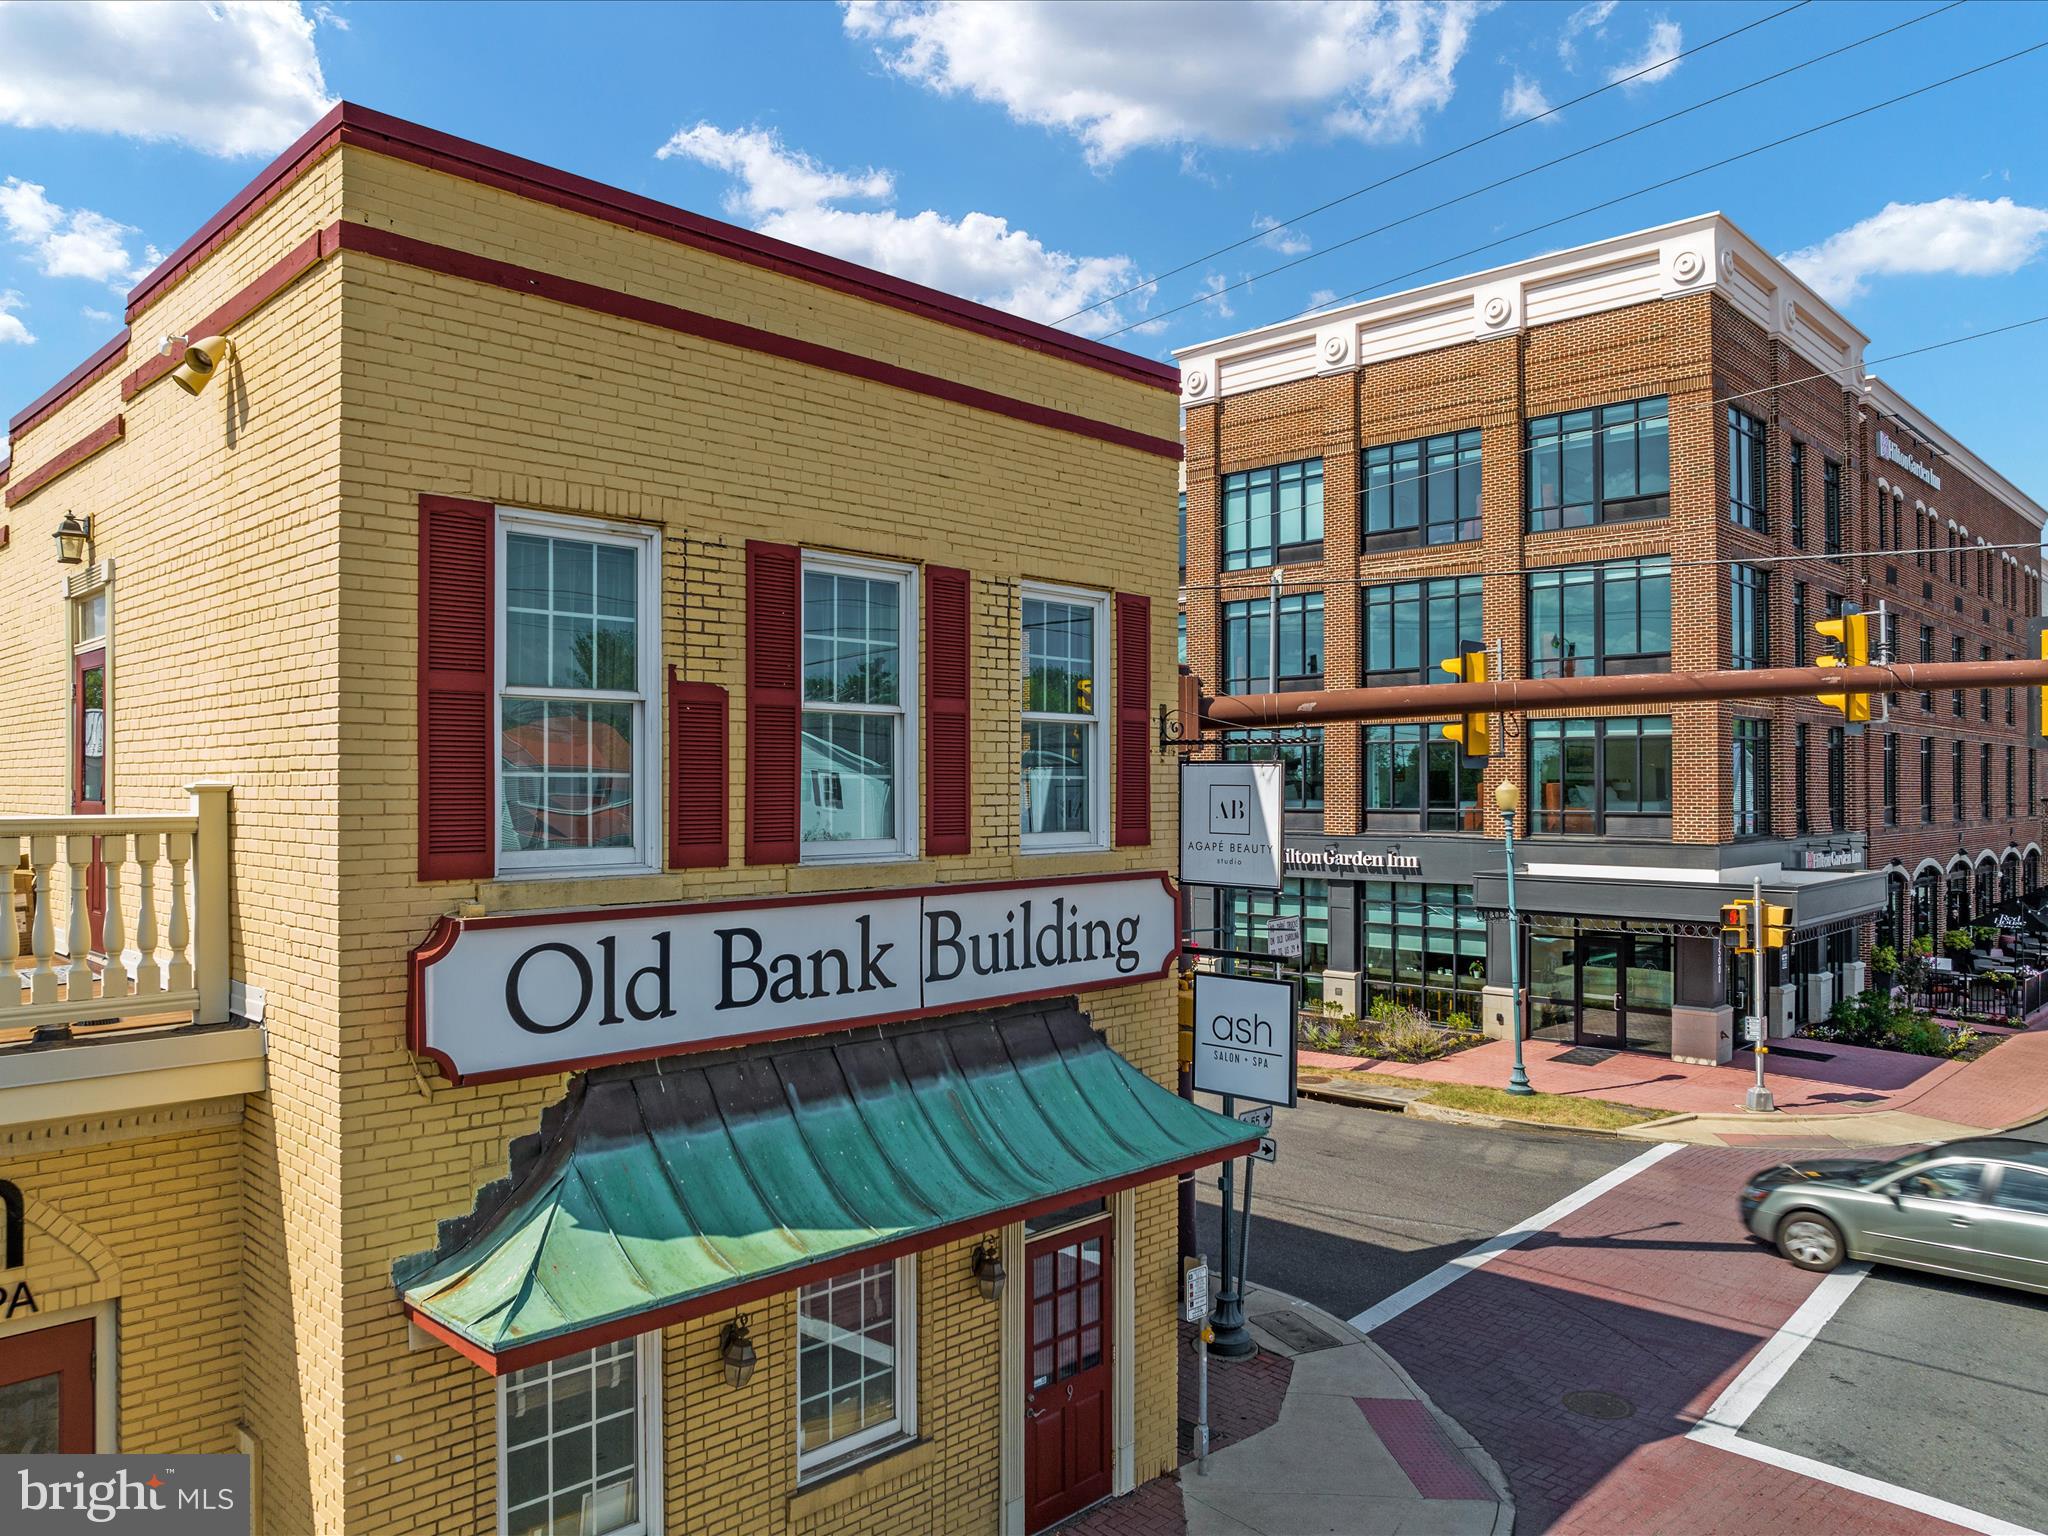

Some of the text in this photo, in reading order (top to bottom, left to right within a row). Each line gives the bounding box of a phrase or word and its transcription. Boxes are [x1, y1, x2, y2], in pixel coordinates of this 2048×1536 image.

[1216, 799, 1245, 819] AB
[1187, 840, 1274, 855] AGAPÉ BEAUTY
[1282, 848, 1419, 868] ilton Garden Inn
[504, 897, 1141, 1035] Old Bank Building
[1212, 1013, 1272, 1047] ash
[1213, 1050, 1268, 1068] SALON SPA
[1067, 1384, 1074, 1401] 9
